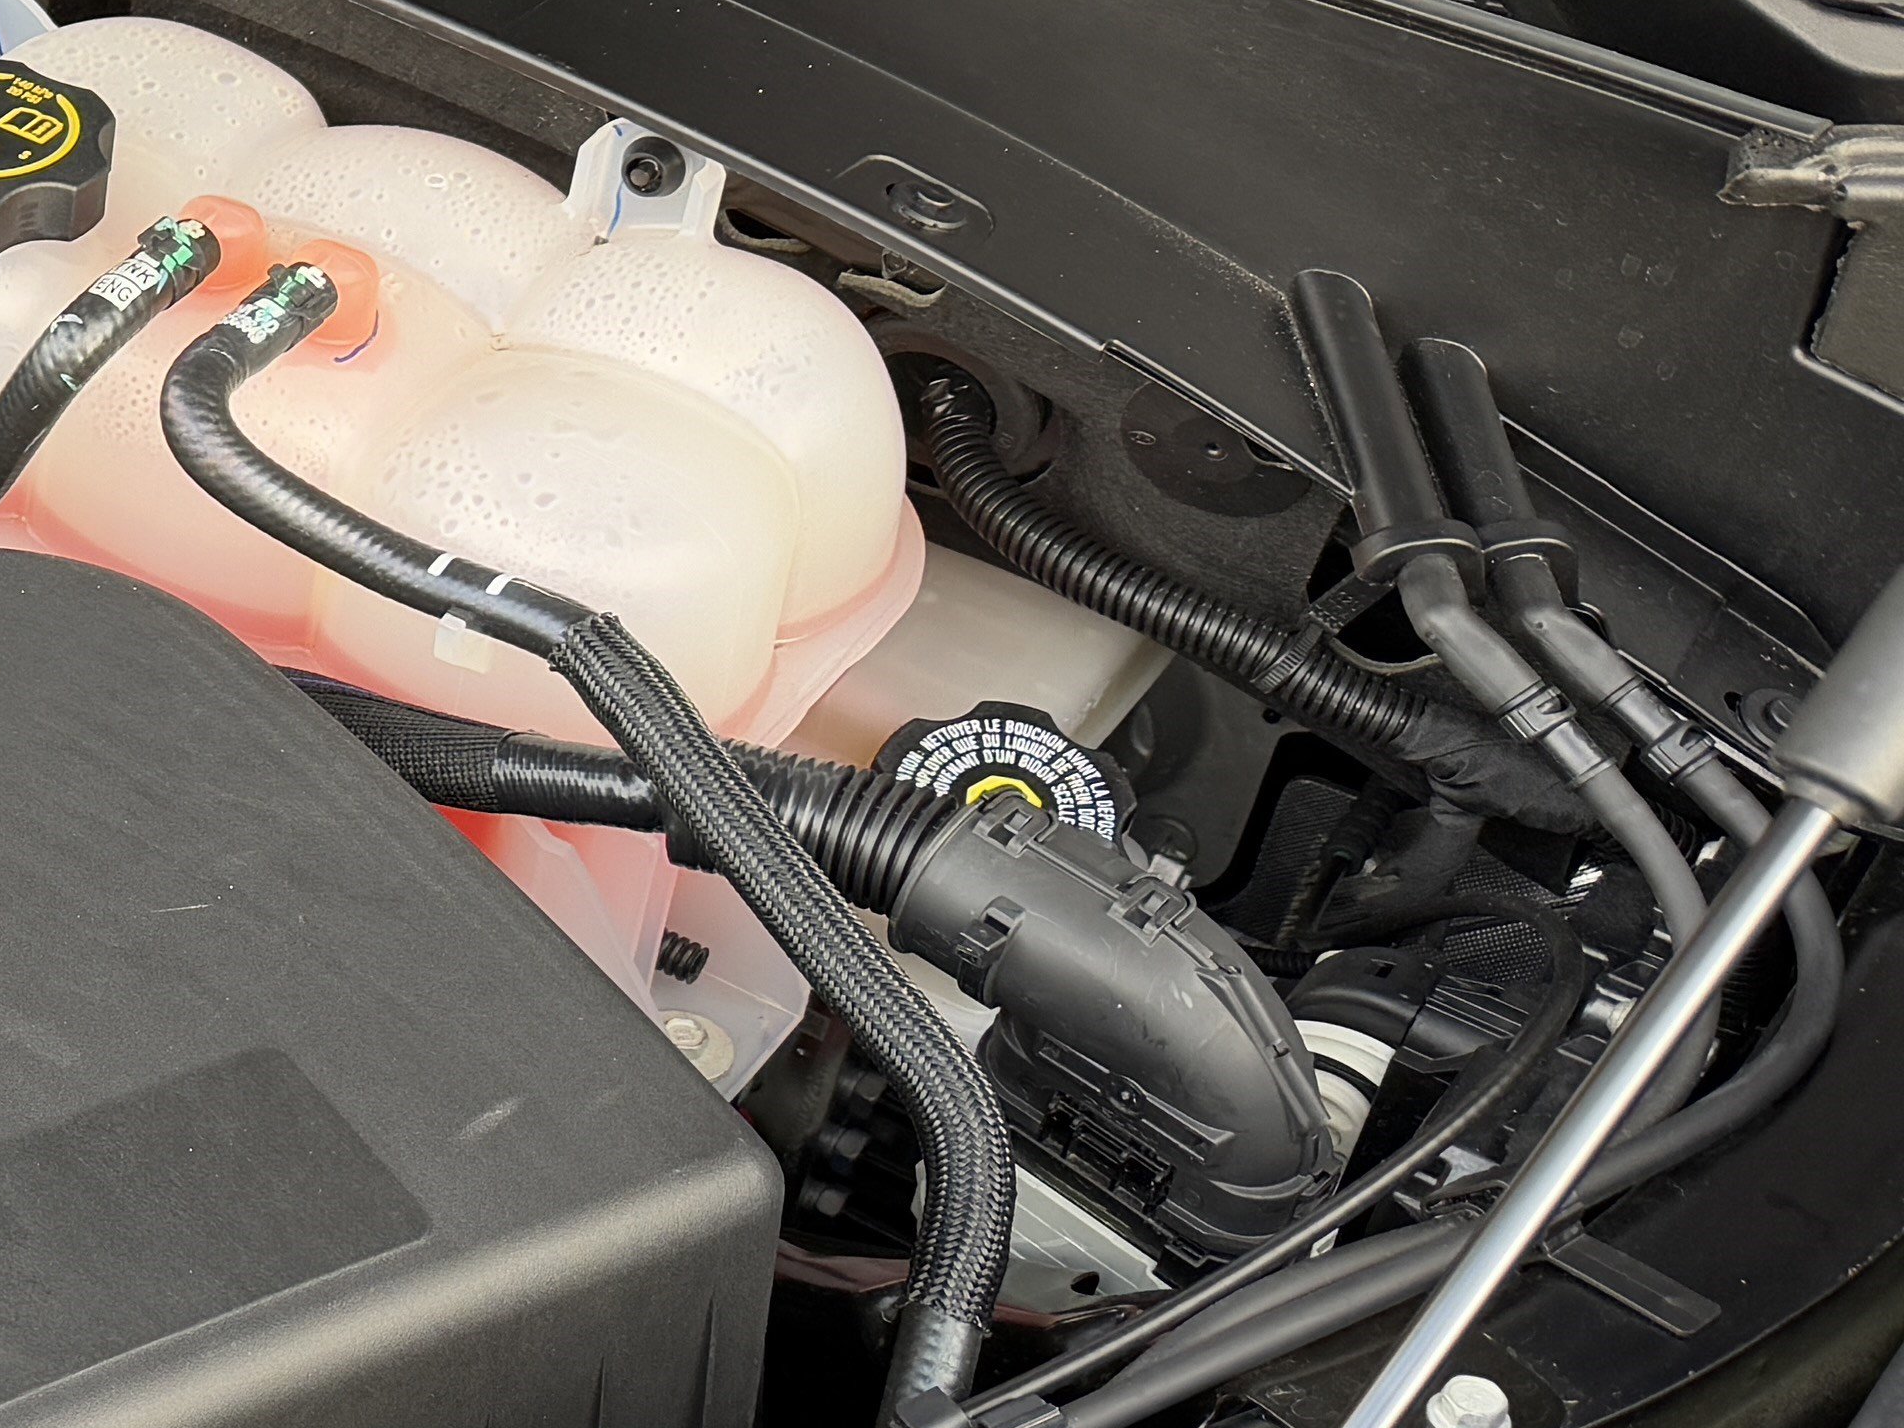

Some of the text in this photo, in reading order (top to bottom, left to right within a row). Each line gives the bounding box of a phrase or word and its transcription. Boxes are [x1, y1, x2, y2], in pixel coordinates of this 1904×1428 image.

[94, 274, 135, 303] ENG
[919, 719, 982, 751] NETTOYER
[984, 718, 1001, 733] LE
[1004, 720, 1068, 755] BOUCHON
[1062, 748, 1102, 780] AVANT
[1089, 781, 1110, 798] LA
[952, 734, 980, 754] QUE
[981, 733, 1001, 748] DU
[1004, 735, 1056, 763] LIQUIDE
[1050, 757, 1074, 775] DE
[1065, 772, 1093, 805] FREIN
[983, 748, 1016, 765] D'UN
[1017, 754, 1060, 785] BIDON
